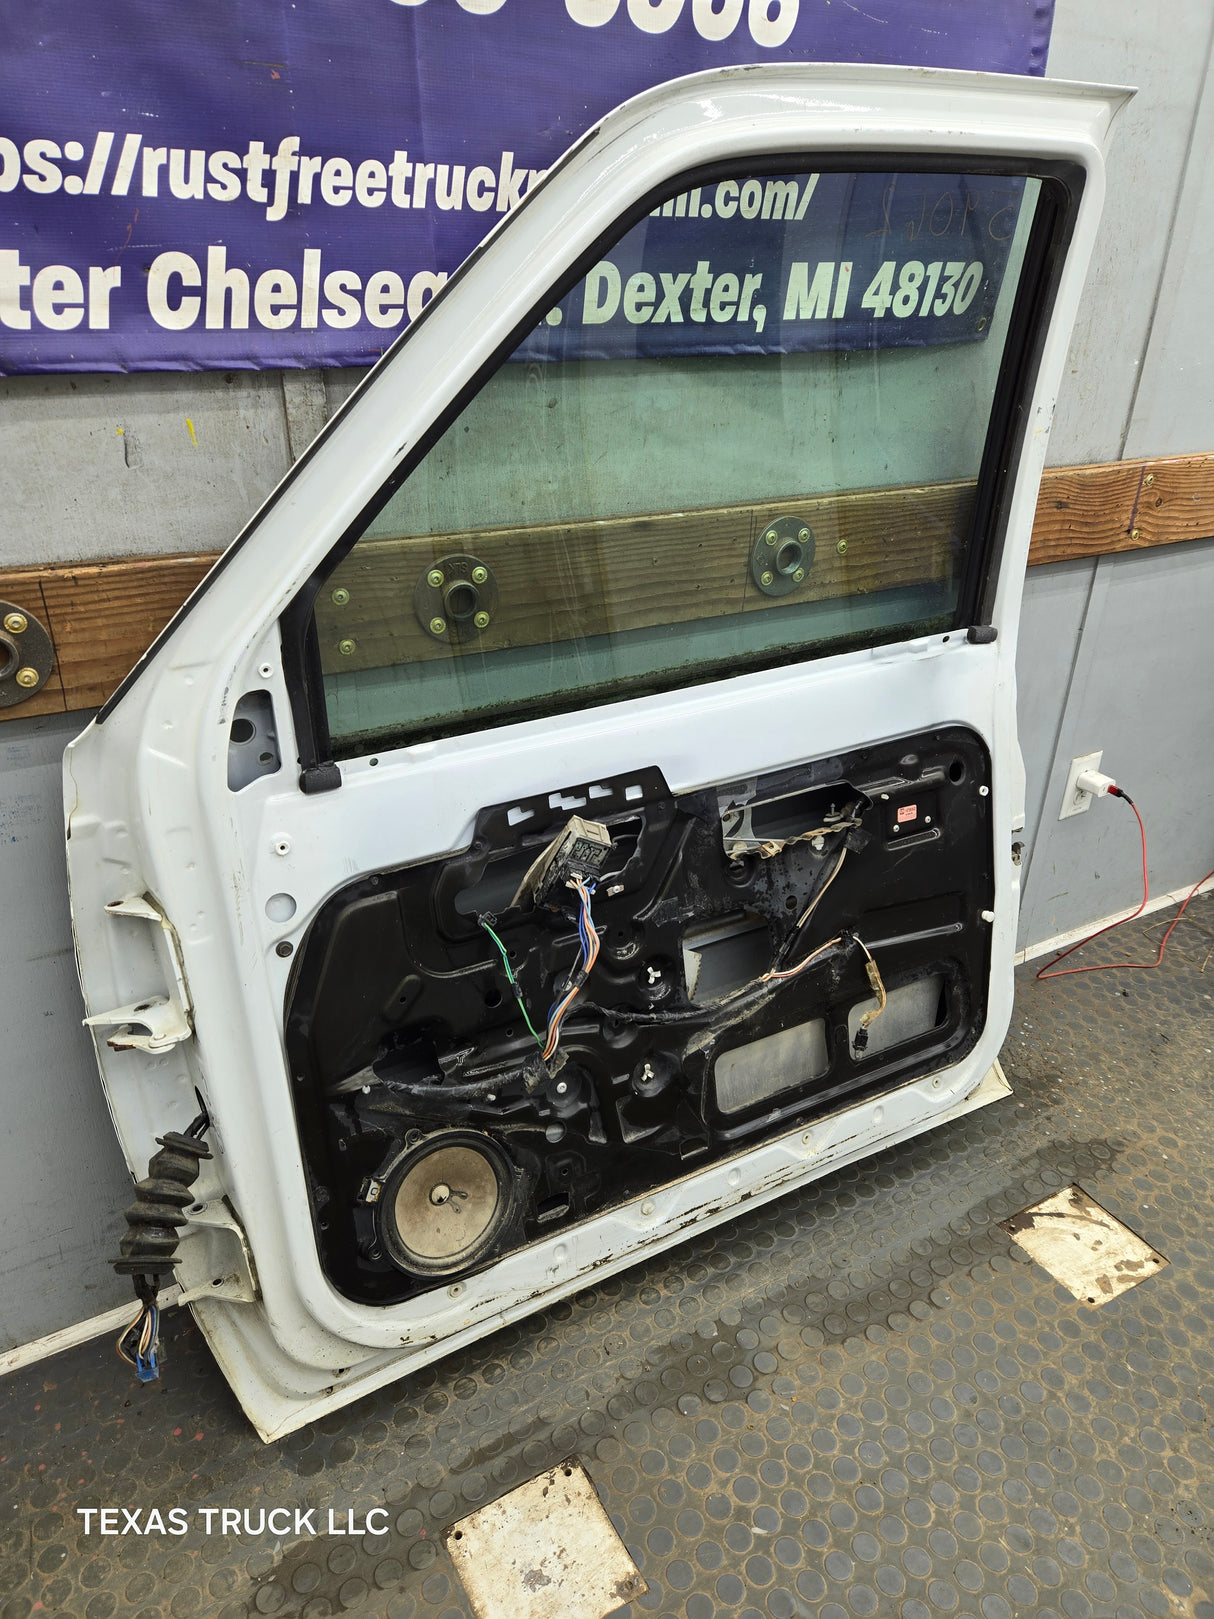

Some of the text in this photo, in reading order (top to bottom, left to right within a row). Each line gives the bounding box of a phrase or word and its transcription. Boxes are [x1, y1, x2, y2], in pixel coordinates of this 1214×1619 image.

[582, 260, 767, 333] Dexter,
[783, 261, 853, 321] MI
[861, 260, 984, 318] 48130
